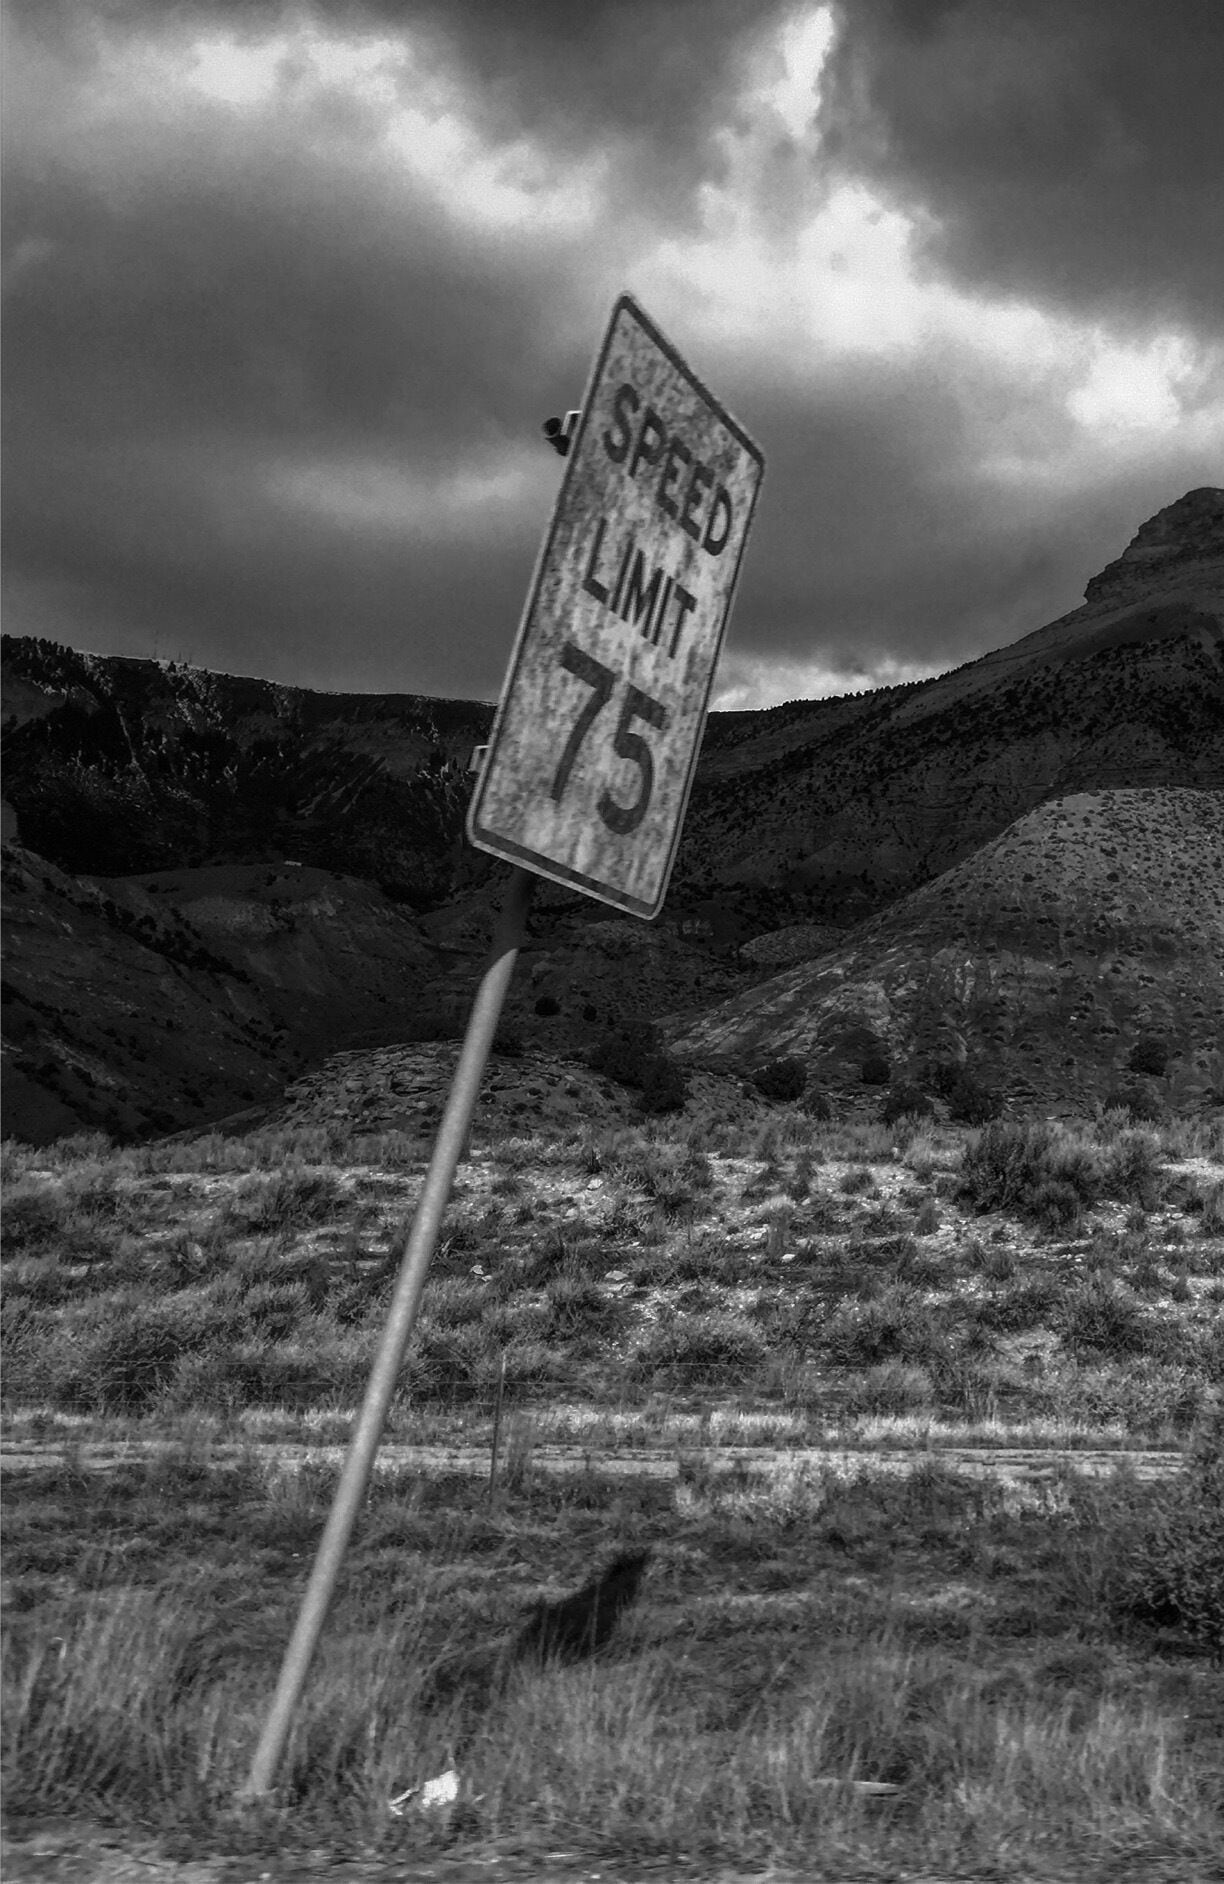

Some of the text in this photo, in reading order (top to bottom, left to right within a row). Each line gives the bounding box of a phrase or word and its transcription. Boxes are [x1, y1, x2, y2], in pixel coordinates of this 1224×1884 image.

[603, 383, 732, 556] SPEED
[582, 518, 698, 659] LIMIT
[551, 642, 668, 835] 75
